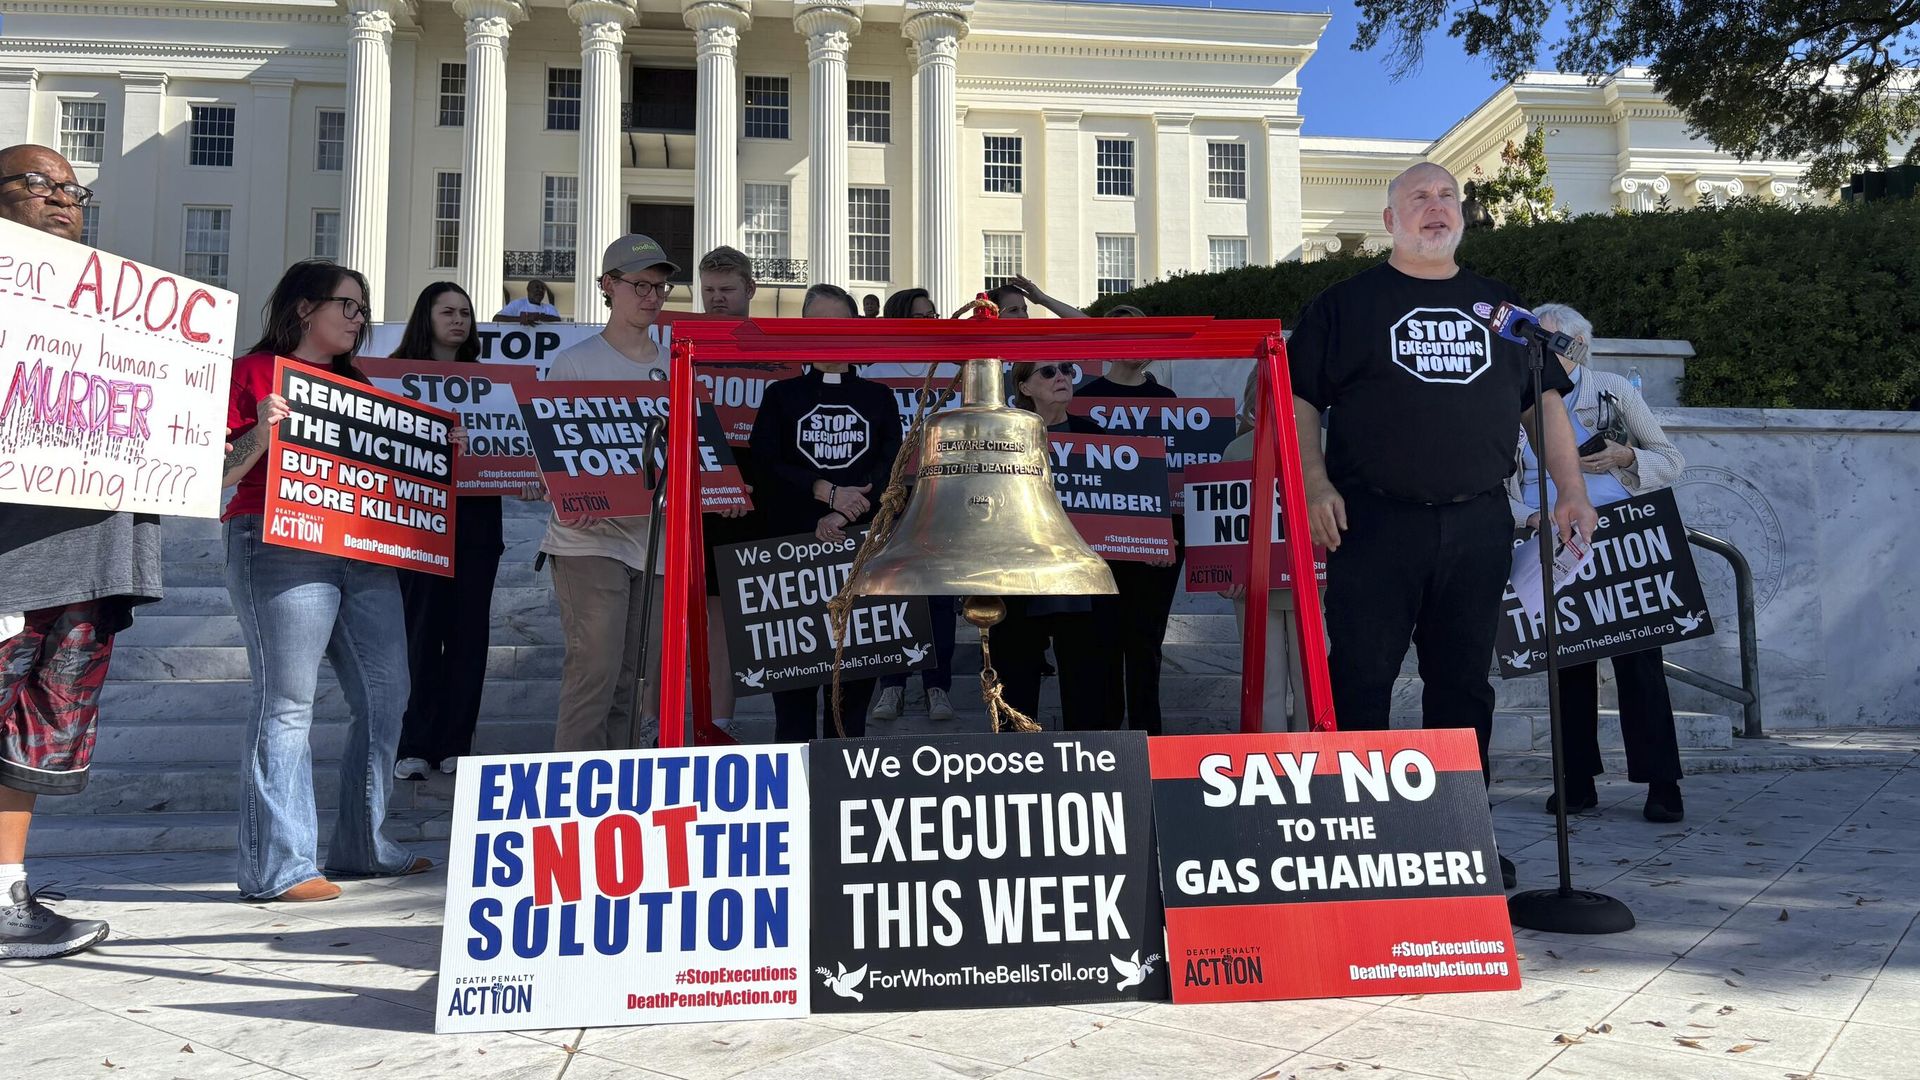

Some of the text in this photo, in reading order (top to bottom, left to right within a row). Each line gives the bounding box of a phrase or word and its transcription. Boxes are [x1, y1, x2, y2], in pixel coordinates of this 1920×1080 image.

[0, 257, 55, 294] ear
[1492, 305, 1509, 327] 12
[1407, 319, 1472, 341] STOP
[478, 331, 560, 360] TOP
[1398, 340, 1484, 356] EXECUTIONS
[26, 334, 82, 371] many
[99, 333, 168, 379] humans
[185, 363, 216, 394] will
[1415, 356, 1472, 373] NOW!
[0, 359, 153, 440] MURDER
[401, 373, 492, 405] STOP
[895, 388, 956, 408] TOP
[288, 375, 448, 446] REMEMBER
[531, 397, 633, 420] DEATH
[1089, 406, 1210, 430] SAY NO
[168, 411, 212, 446] this
[552, 422, 583, 445] IS
[811, 414, 857, 431] STOP
[288, 410, 448, 476] THE VICTIMS
[466, 435, 535, 457] IONS!
[803, 430, 864, 444] EXECUTIONS
[936, 440, 1025, 453] DELAWARE CITIZENS
[553, 446, 722, 477] TORTE
[814, 443, 852, 459] NOW!
[1085, 443, 1139, 470] NO
[281, 449, 447, 509] BUT NOT WITH
[918, 465, 943, 478] PPOSED
[946, 465, 958, 474] TO
[960, 464, 979, 473] THE
[981, 463, 1012, 473] DEATH
[1071, 473, 1102, 486] THE
[562, 495, 611, 513] ACTION
[701, 486, 742, 495] Executions
[1056, 490, 1162, 512] HAMBER!
[1193, 482, 1252, 511] THO
[275, 507, 325, 522] DEATH PENALTY
[279, 477, 447, 534] MORE KILLING
[1613, 503, 1656, 525] The
[270, 514, 324, 545] ACTION
[1104, 535, 1168, 545] #StopExecutions
[1214, 514, 1251, 543] NO
[343, 533, 450, 568] DeathPenaltyAction.org
[735, 547, 771, 566] We
[777, 537, 856, 563] Oppose
[1090, 544, 1169, 556] athPenaltyAction.org
[737, 563, 854, 615] EXECUT
[1190, 569, 1232, 583] ACTION
[1583, 571, 1684, 626] WEEK
[745, 602, 913, 660] THIS WEEK
[1531, 622, 1674, 661] FohomTheBellsToll.org
[842, 741, 1116, 783] We Oppose The
[477, 753, 788, 821] EXECUTION
[1199, 748, 1436, 808] SAY NO
[839, 791, 1127, 864] EXECUTION
[1277, 816, 1376, 842] TO THE
[472, 805, 790, 906] IS NOT THE
[1175, 850, 1487, 895] GAS CHAMBER!
[467, 887, 788, 961] SOLUTION
[842, 874, 1131, 950] THIS WEEK
[1392, 939, 1505, 957] #StopExecutions
[456, 974, 535, 984] DEATH PENALTY
[675, 966, 797, 986] #StopExecutions
[869, 964, 1109, 989] ForWhomTheBellsToll.org
[1185, 955, 1263, 987] ACTION
[1349, 960, 1509, 980] DeathPenaltyAction.org
[448, 982, 533, 1017] ACTION
[627, 988, 797, 1010] DeathPenaltyAction.org
